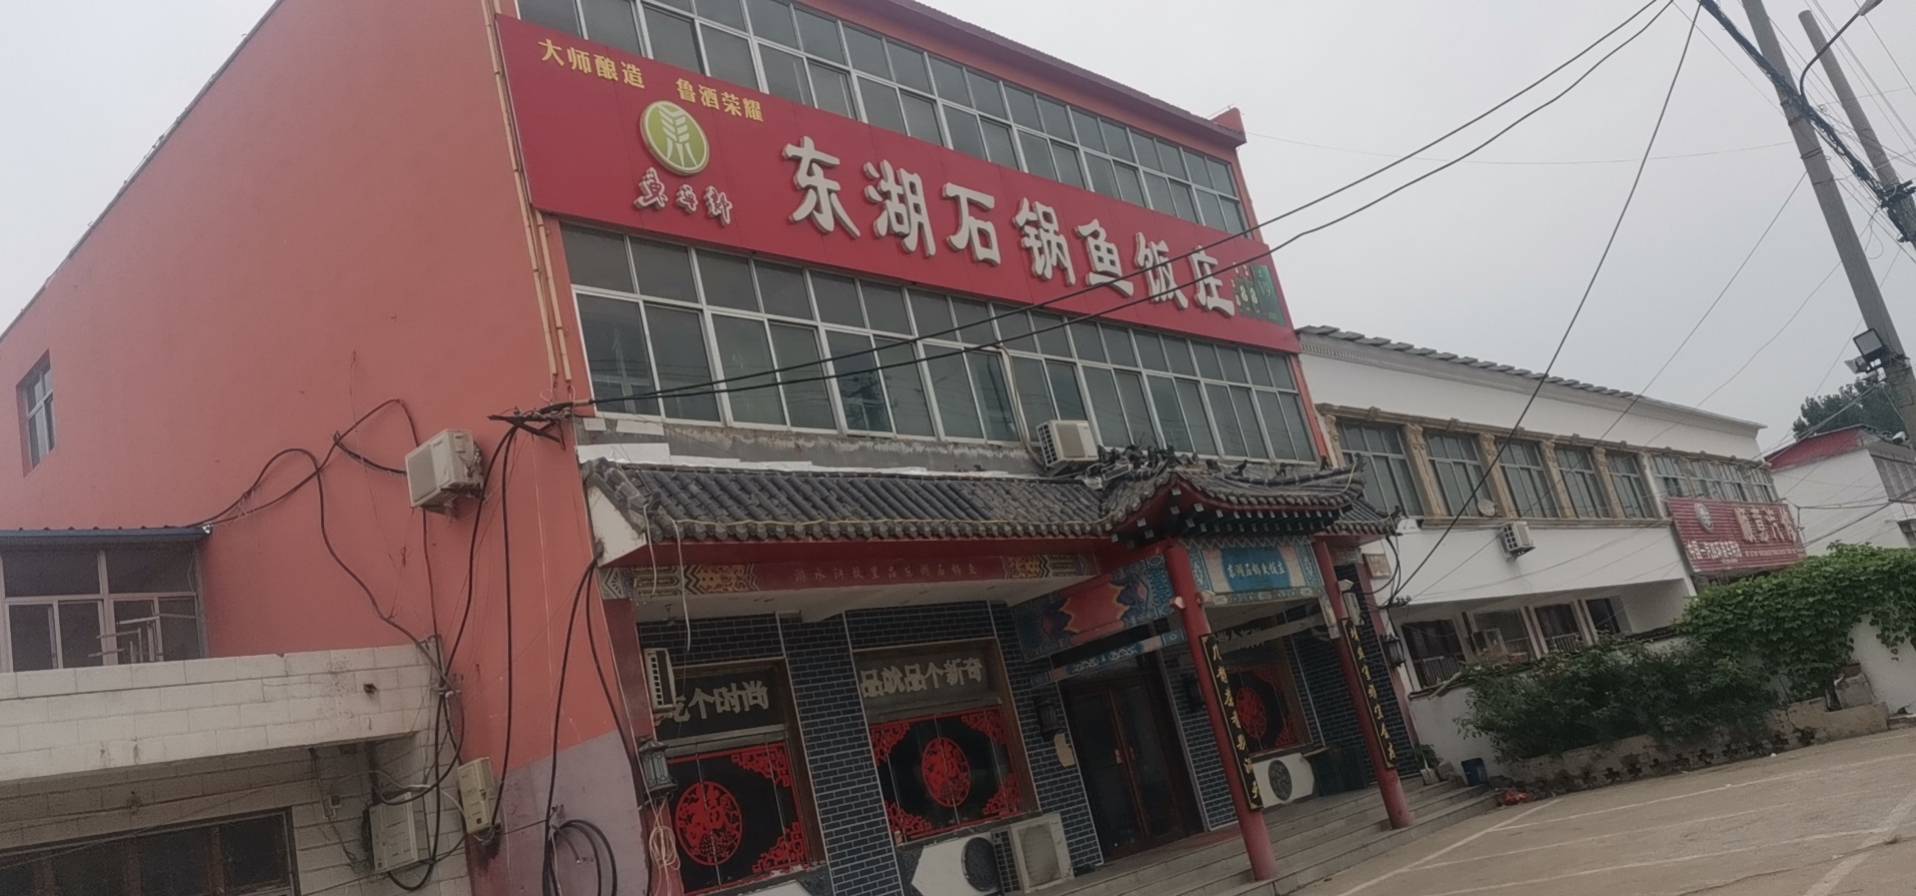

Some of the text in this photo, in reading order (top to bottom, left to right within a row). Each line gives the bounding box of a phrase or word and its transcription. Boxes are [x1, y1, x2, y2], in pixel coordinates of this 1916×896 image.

[538, 38, 764, 122] 大师酿造 鲁酒荣耀
[782, 136, 1236, 319] 东湖石锅鱼饭庄
[859, 656, 983, 699] 品就品个新奇
